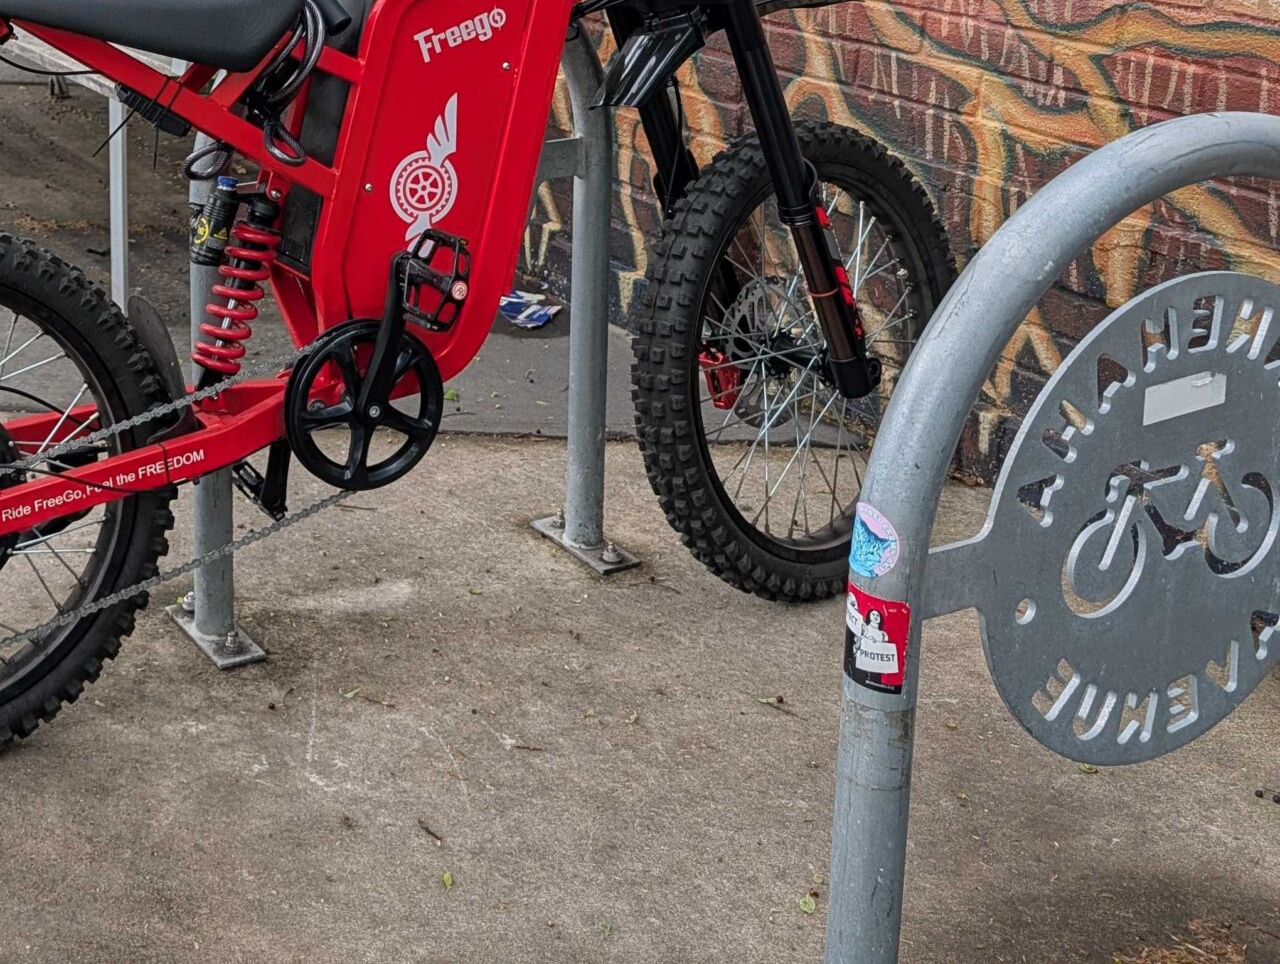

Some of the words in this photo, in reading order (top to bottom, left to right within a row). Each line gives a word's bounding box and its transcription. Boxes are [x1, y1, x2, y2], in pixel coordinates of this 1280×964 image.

[414, 6, 506, 63] Freego
[1, 504, 32, 522] Ride
[34, 489, 86, 513] FreeGo,
[116, 472, 135, 487] the
[138, 449, 205, 479] FREEDOM
[860, 648, 895, 662] PROTEST
